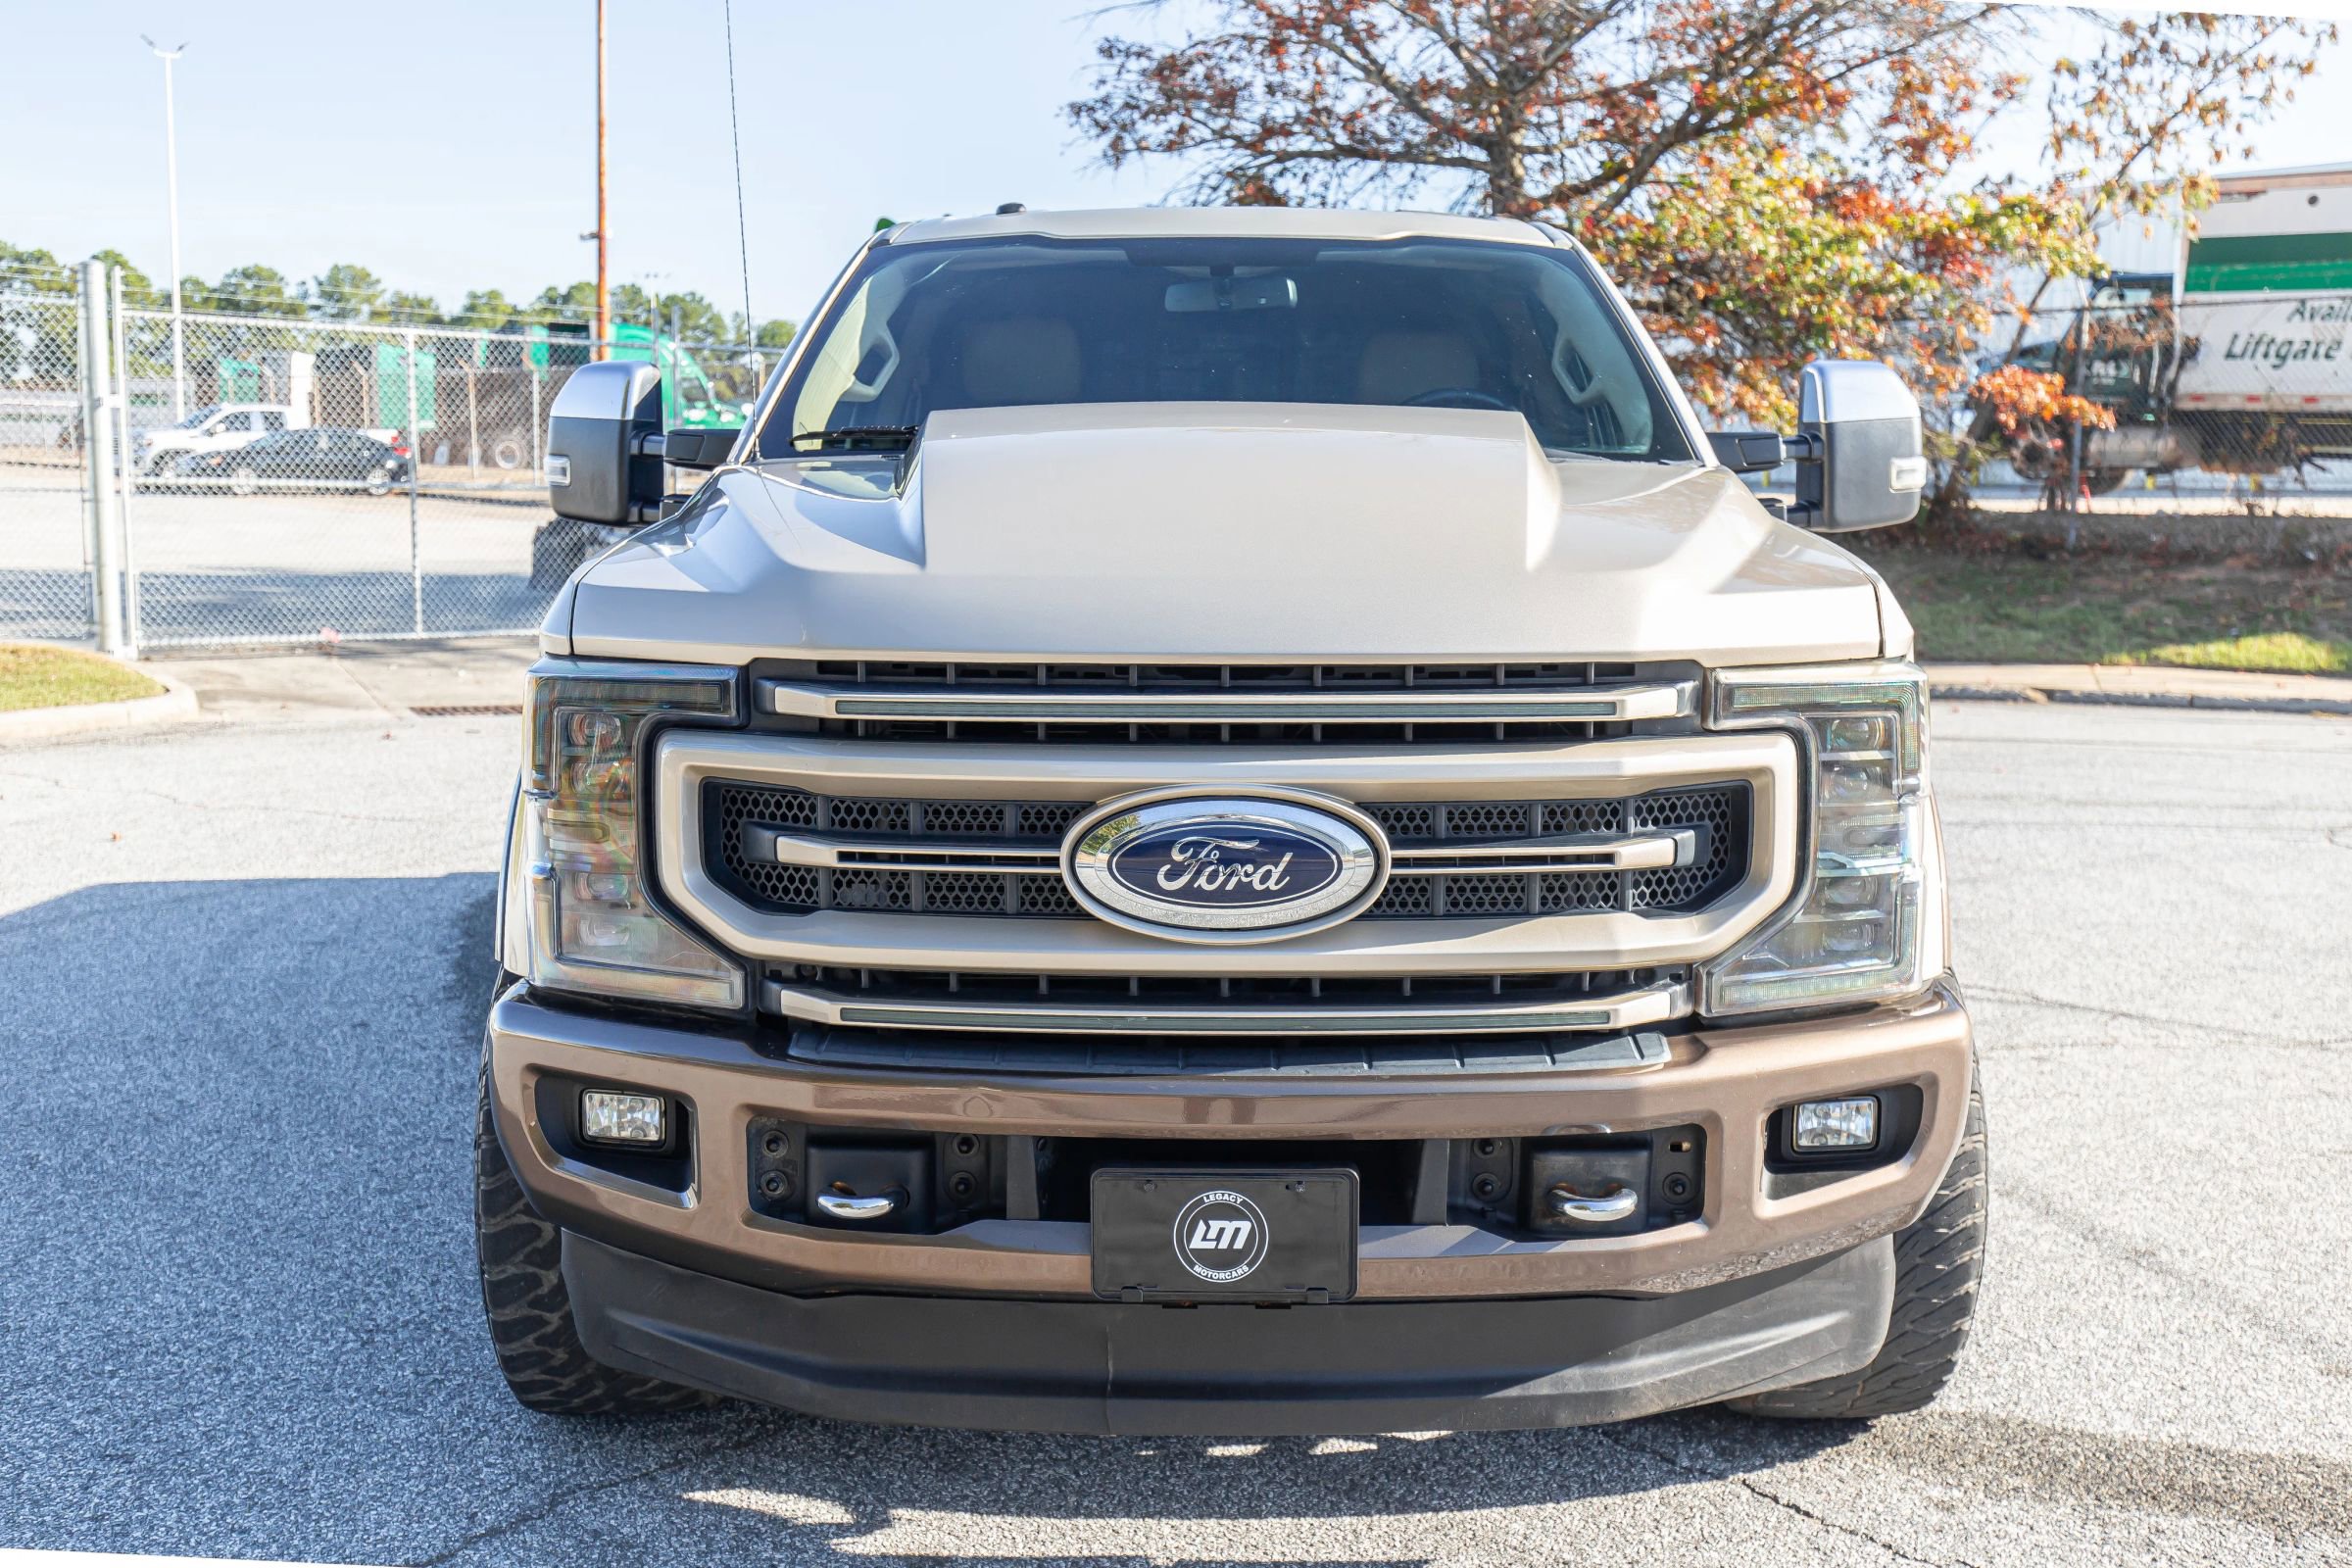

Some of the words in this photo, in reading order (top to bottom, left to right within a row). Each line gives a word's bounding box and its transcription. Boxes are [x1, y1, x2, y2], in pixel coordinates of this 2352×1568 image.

[2286, 298, 2352, 322] Avail
[2224, 331, 2342, 369] Liftgate
[1156, 836, 1293, 891] Ford
[1203, 1193, 1244, 1204] LEGACY
[1193, 1265, 1250, 1280] MOTORCARS
